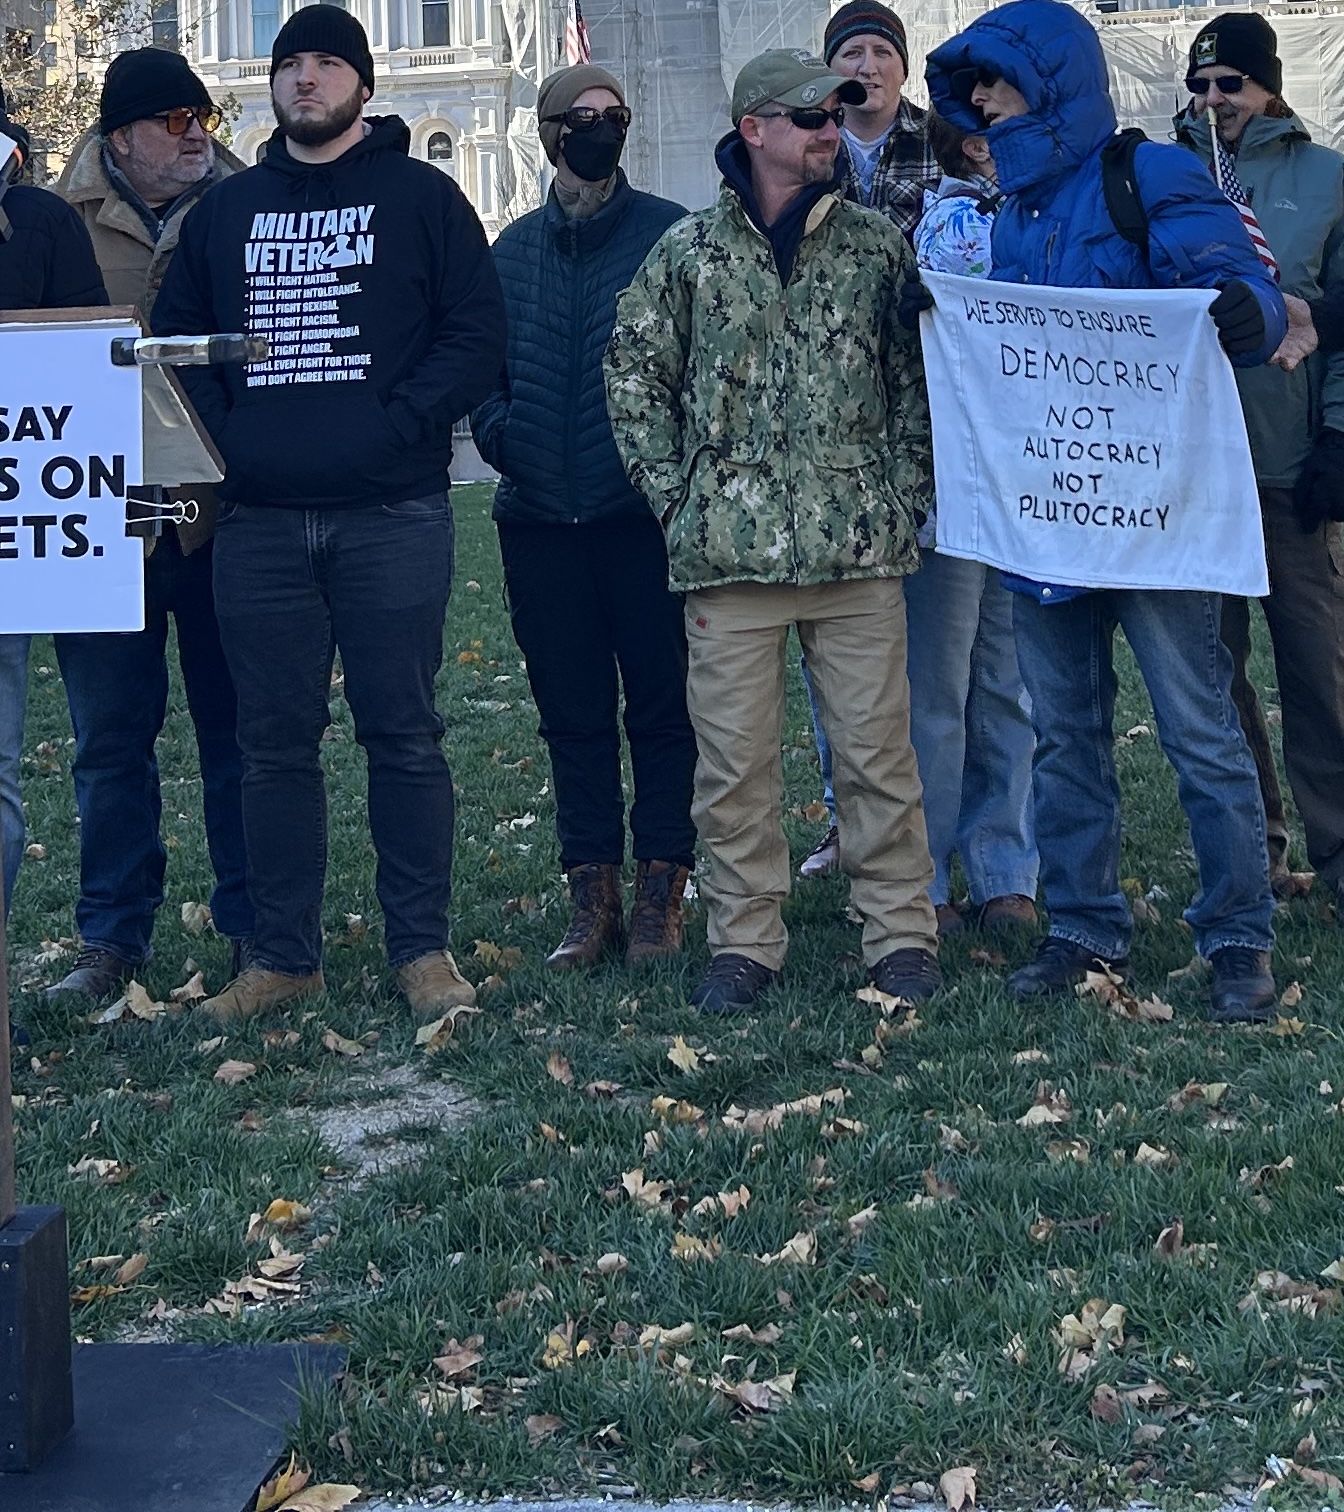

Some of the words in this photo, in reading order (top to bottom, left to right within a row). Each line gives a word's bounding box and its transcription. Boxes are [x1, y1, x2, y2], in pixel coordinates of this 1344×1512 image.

[250, 204, 376, 240] MILITARY
[245, 234, 375, 273] VETERN
[255, 290, 275, 300] WILL
[276, 289, 302, 300] FIGHT
[302, 281, 363, 299] INTOLERANCE.
[256, 276, 275, 286] WILL
[276, 276, 303, 286] FIGHT
[303, 272, 340, 285] HATRED.
[254, 304, 275, 315] WILL
[275, 302, 302, 314] FIGHT
[302, 299, 339, 313] SEXISM.
[963, 296, 994, 325] WE
[995, 300, 1047, 328] SERVED
[1048, 307, 1074, 329] TO
[1075, 309, 1157, 338] ENSURE
[254, 318, 274, 329] WILL
[275, 316, 301, 328] FIGHT
[301, 313, 340, 326] RACISM.
[274, 330, 301, 342] FIGHT
[274, 344, 300, 356] FIGHT
[300, 342, 334, 355] ANGER.
[252, 361, 273, 373] WILL
[273, 359, 297, 371] EVEN
[297, 357, 324, 369] FIGHT
[324, 356, 343, 367] FOR
[343, 353, 372, 366] THOSE
[1000, 342, 1180, 394] DEMOCRACY
[246, 375, 267, 387] WHO
[267, 373, 294, 386] DON'T
[294, 371, 324, 383] AGREE
[324, 369, 348, 382] WITH
[349, 368, 367, 380] ME.
[1045, 404, 1115, 430] NOT
[1023, 435, 1162, 470] AUTOCRACY
[40, 454, 125, 500] ON
[1052, 471, 1103, 494] NOT
[1019, 494, 1169, 531] PLUTOCRACY
